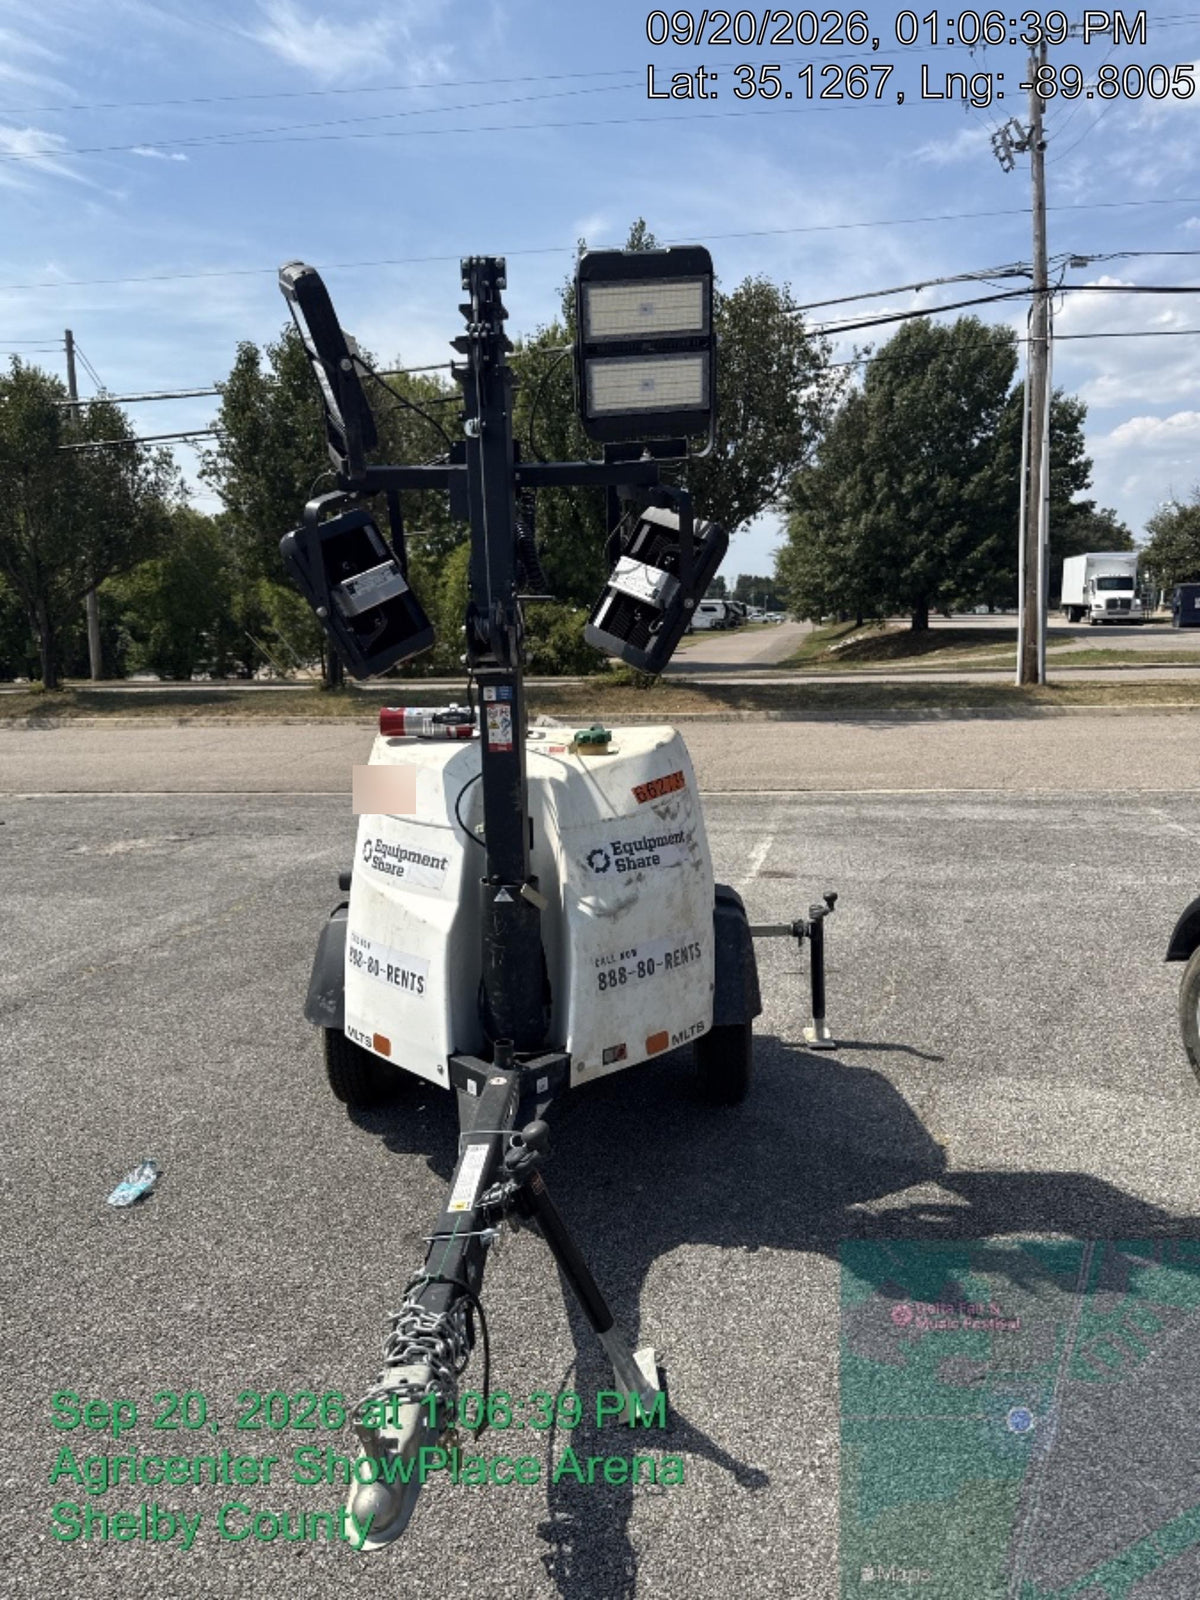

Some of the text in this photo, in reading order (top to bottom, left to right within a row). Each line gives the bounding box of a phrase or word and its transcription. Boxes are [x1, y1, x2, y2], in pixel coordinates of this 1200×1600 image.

[374, 838, 449, 870] Equipment
[610, 831, 685, 856] Equipment
[371, 855, 404, 877] Share
[615, 854, 660, 873] Share
[595, 956, 616, 968] CALL
[598, 942, 702, 991] 888-80-RENTS
